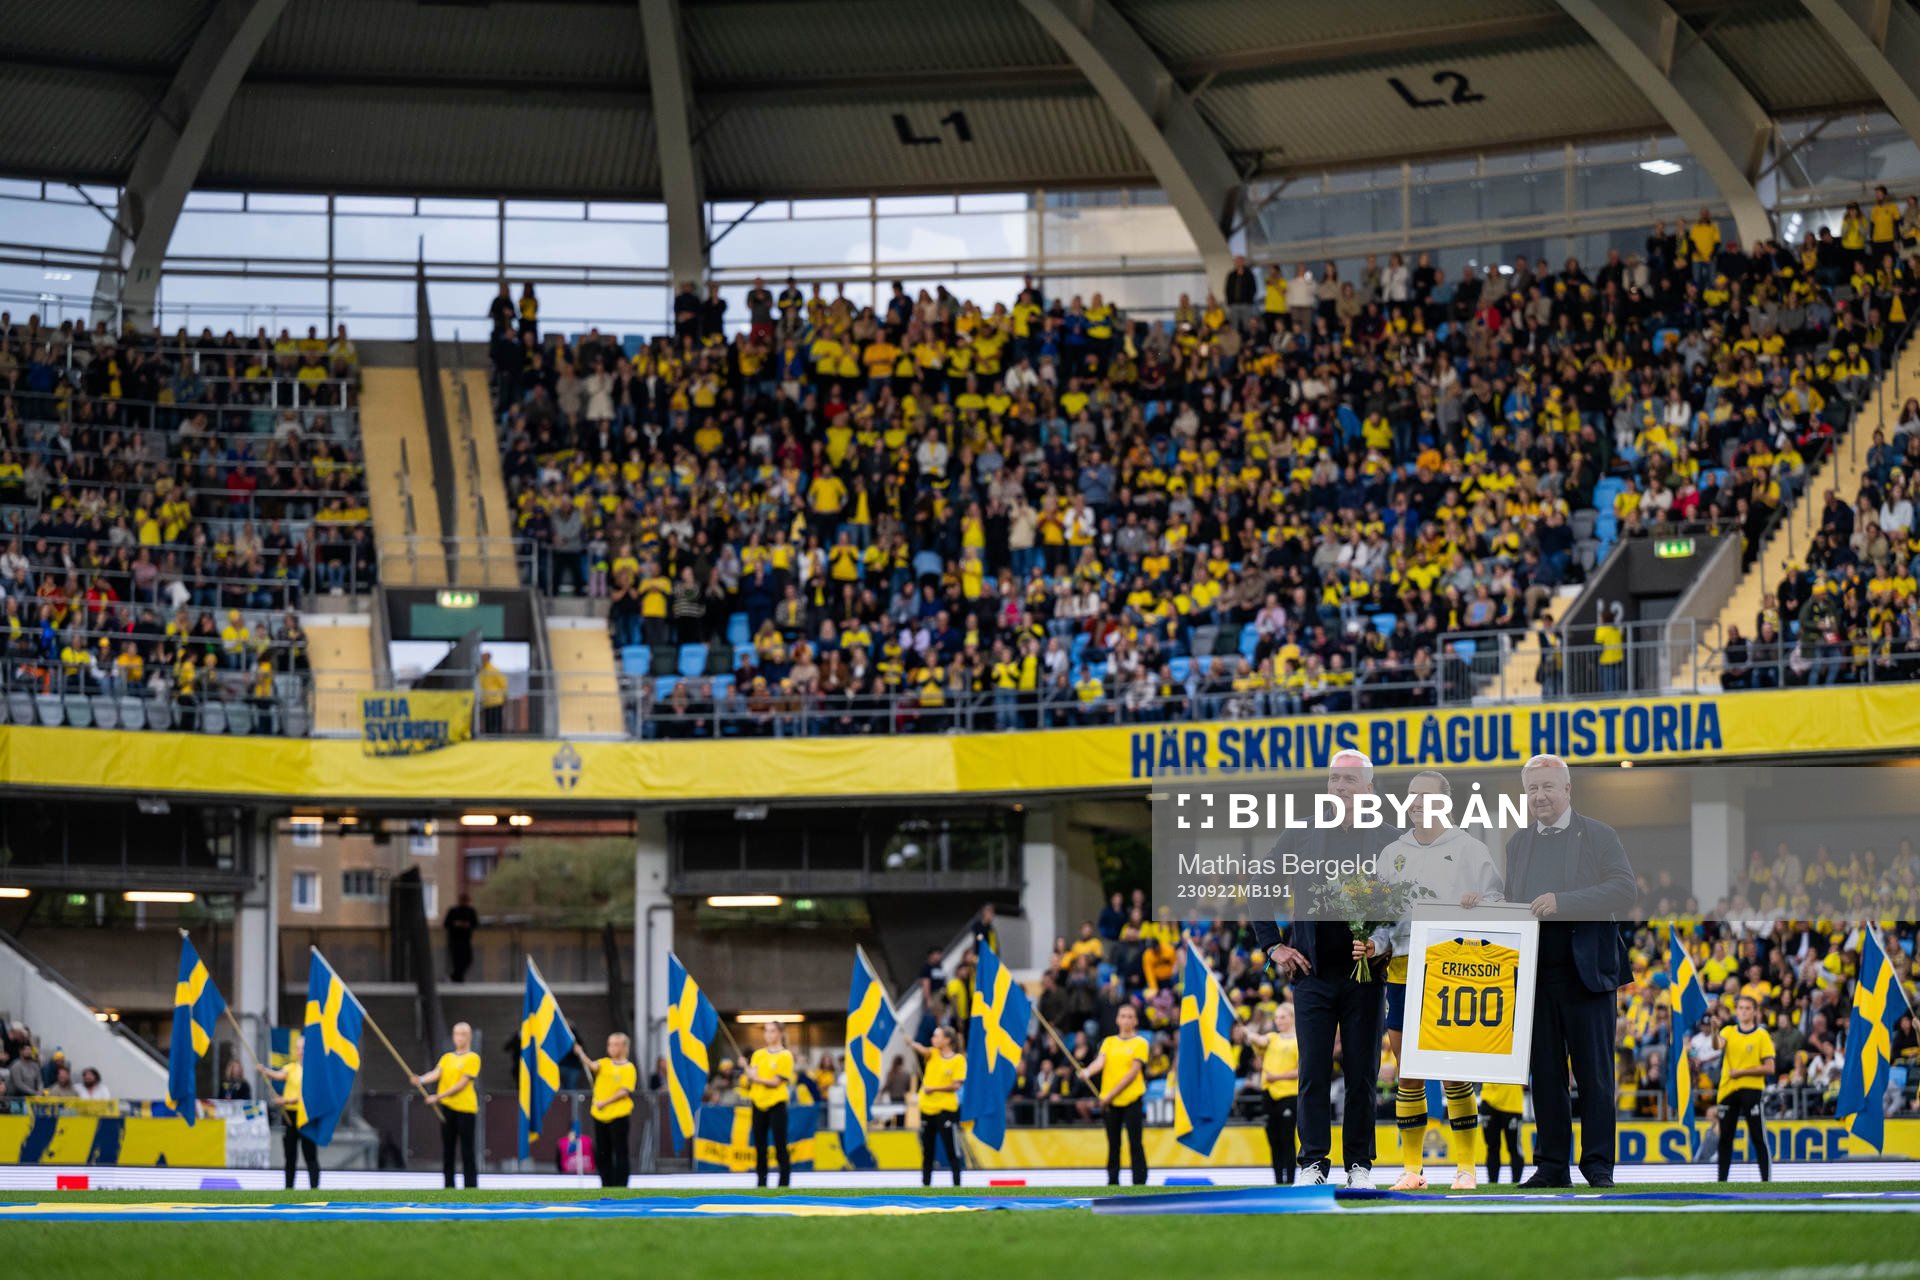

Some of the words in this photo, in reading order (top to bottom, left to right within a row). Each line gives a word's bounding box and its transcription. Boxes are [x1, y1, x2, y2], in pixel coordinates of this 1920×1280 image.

[1386, 71, 1484, 109] L2
[892, 111, 973, 146] L1
[364, 698, 410, 718] HEJA
[1131, 728, 1207, 779] HÄR
[1217, 721, 1360, 774] SKRIVS
[1370, 713, 1520, 766] BLÅGUL
[1530, 702, 1723, 757] HISTORIA
[1442, 961, 1501, 977] ERIKSSON
[1436, 985, 1504, 1027] 100
